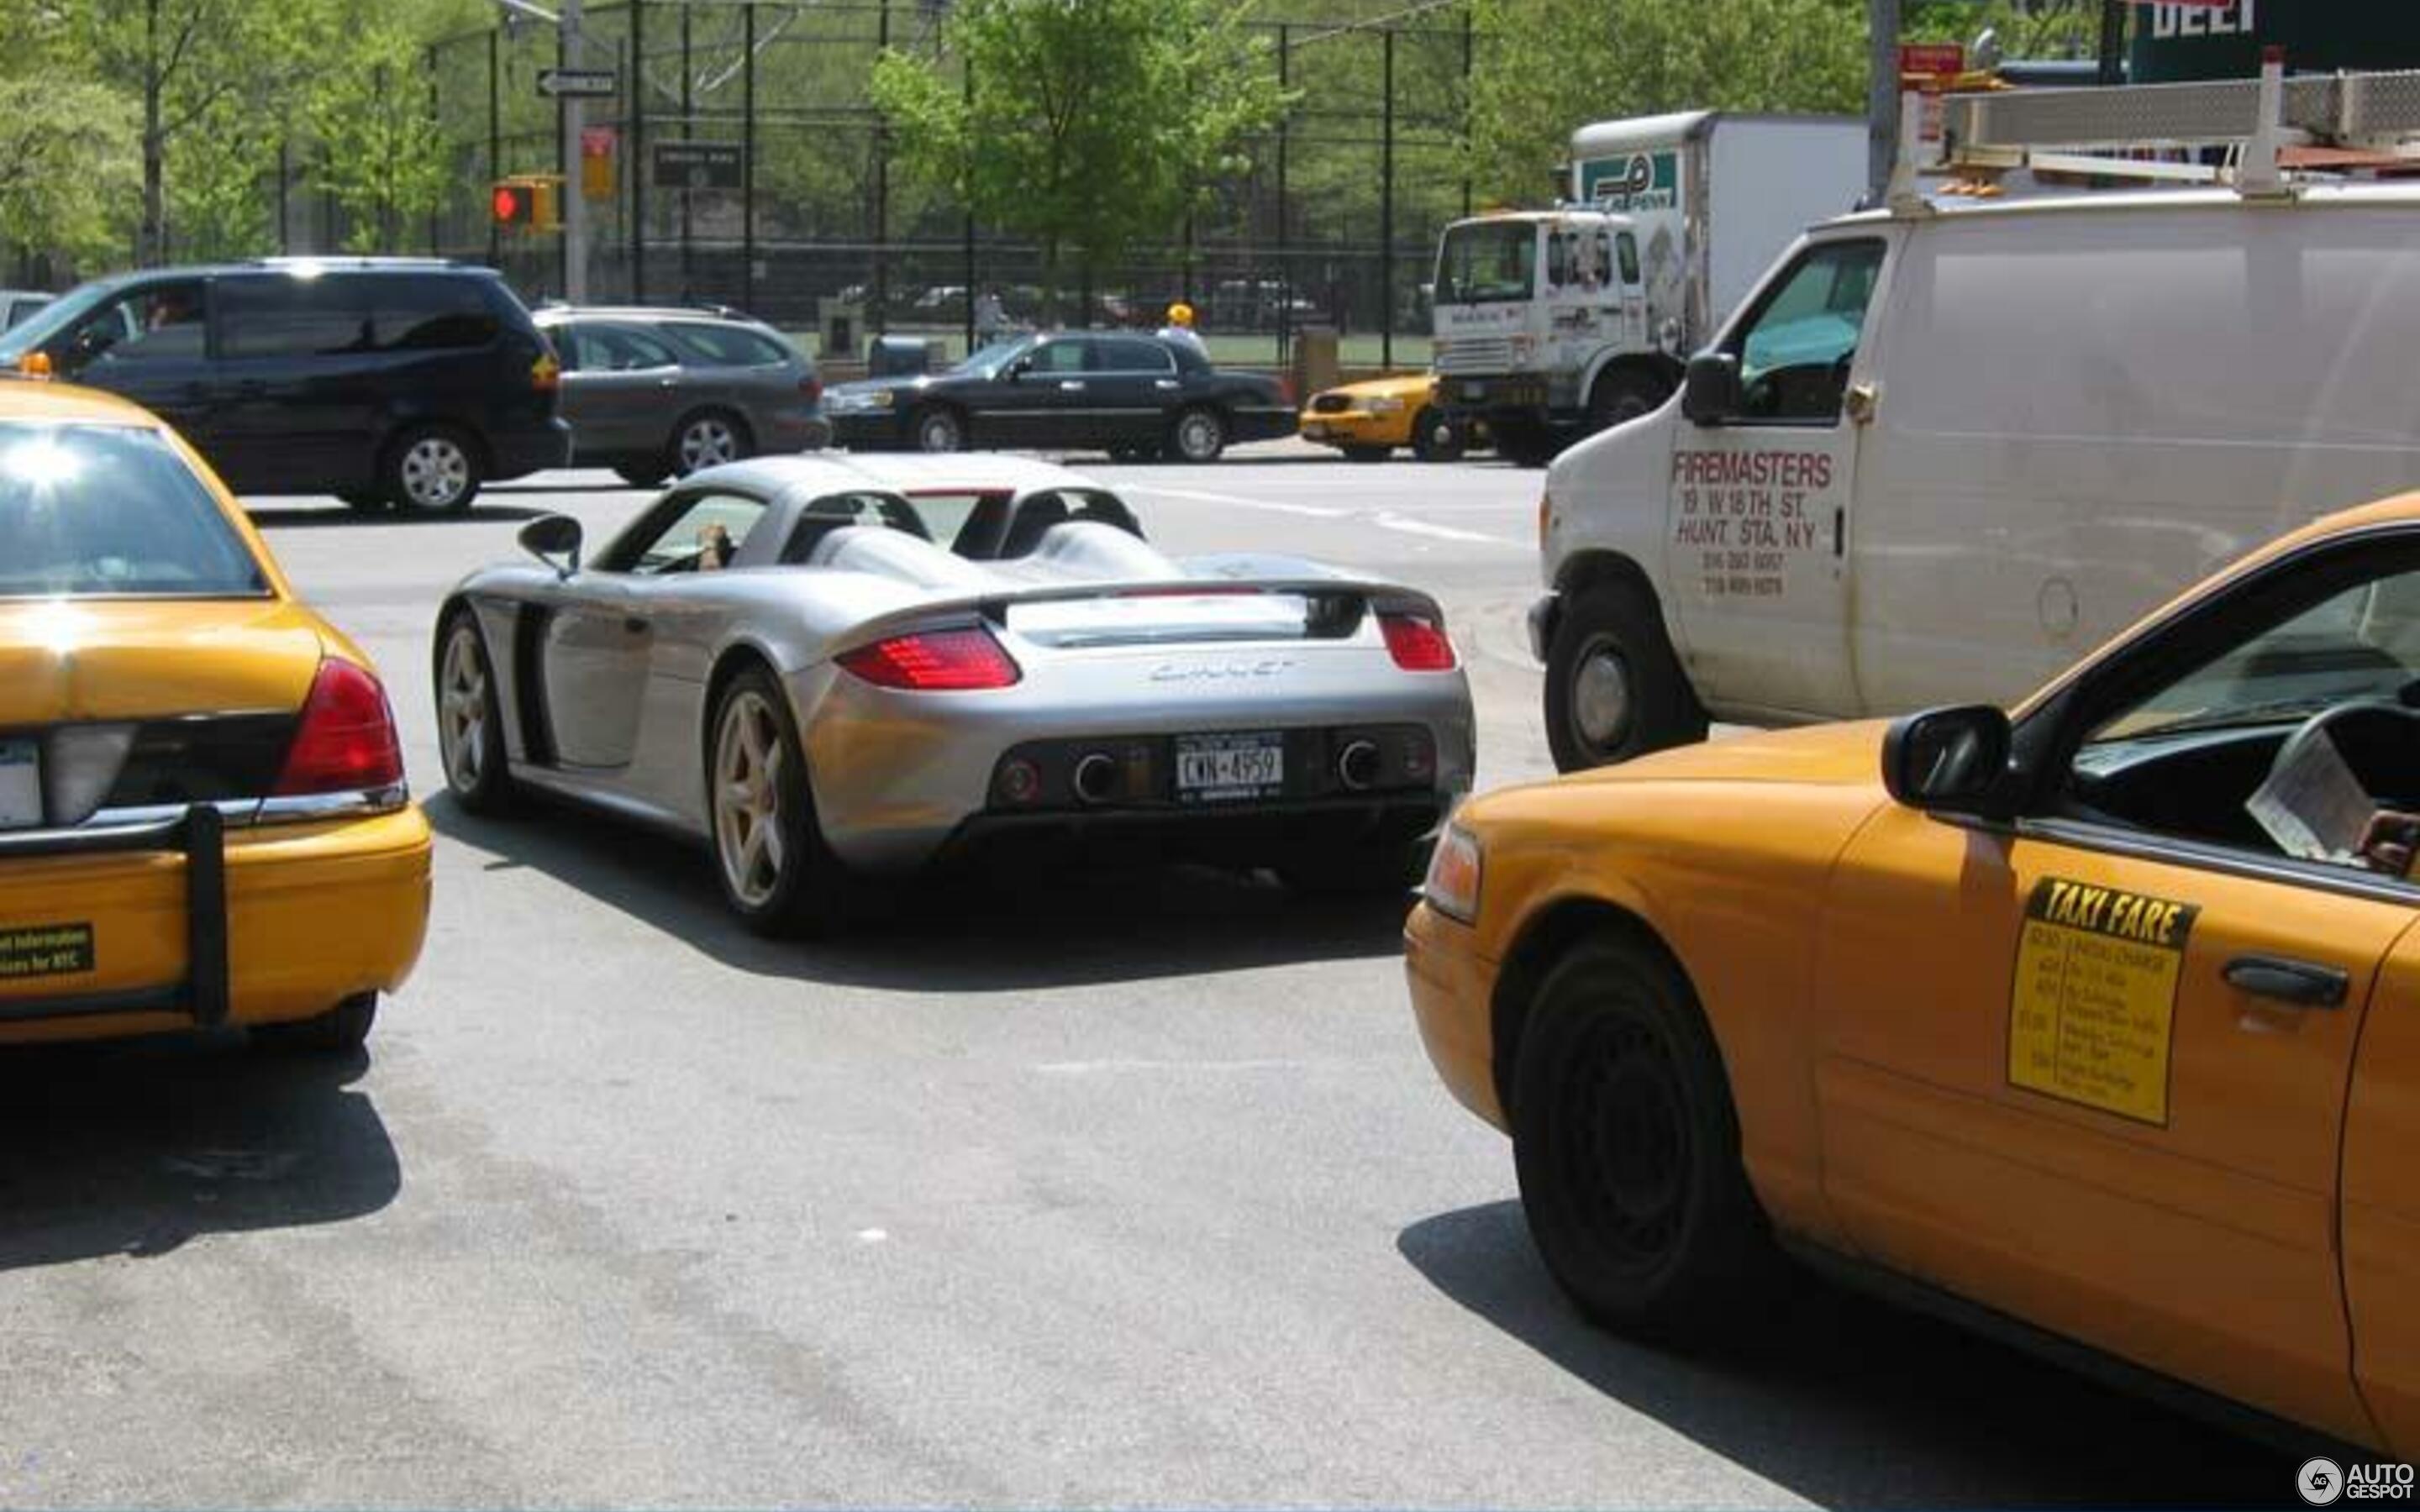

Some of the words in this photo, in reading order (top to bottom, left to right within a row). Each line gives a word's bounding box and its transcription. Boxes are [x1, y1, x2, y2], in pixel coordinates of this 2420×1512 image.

[1671, 450, 1832, 489] FIREMASTERS
[2045, 881, 2110, 927] TAXI
[2107, 894, 2182, 943] FARE
